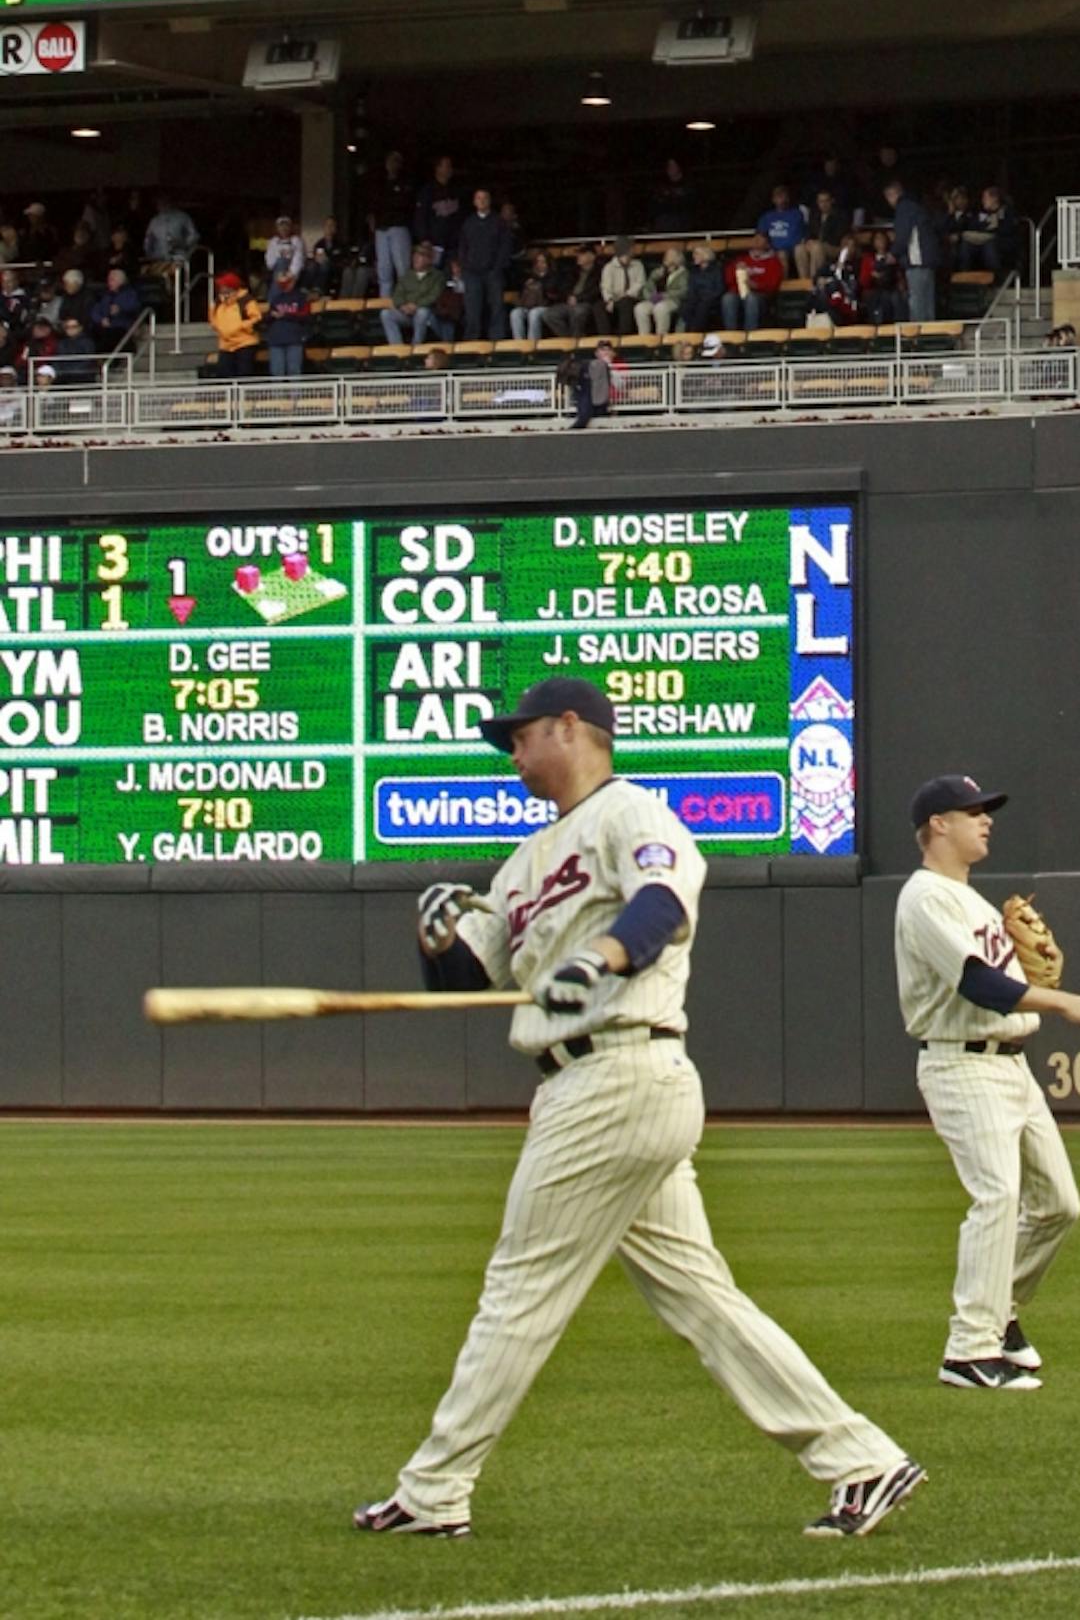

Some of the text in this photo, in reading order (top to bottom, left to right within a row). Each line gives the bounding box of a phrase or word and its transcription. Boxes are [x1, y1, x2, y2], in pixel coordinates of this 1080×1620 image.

[317, 523, 333, 564] 1
[553, 511, 749, 547] D. MOSELEY
[98, 534, 129, 580] 3
[400, 524, 475, 572] SD
[168, 559, 186, 596] 1
[598, 550, 692, 584] 7:40
[101, 584, 129, 630] 1
[381, 576, 498, 623] COL
[537, 583, 768, 619] J. DE LA ROSA
[169, 641, 271, 672] D. GEE
[389, 641, 481, 689] ARI
[543, 631, 760, 664] J. SAUNDERS
[170, 678, 260, 710] 7:05
[605, 669, 684, 702] 9:10
[143, 710, 299, 743] B. NORRIS
[384, 693, 495, 740] LAD
[116, 760, 326, 791] J. MCDONALD
[177, 798, 252, 829] 7:10
[117, 831, 323, 861] Y. GALLARDO
